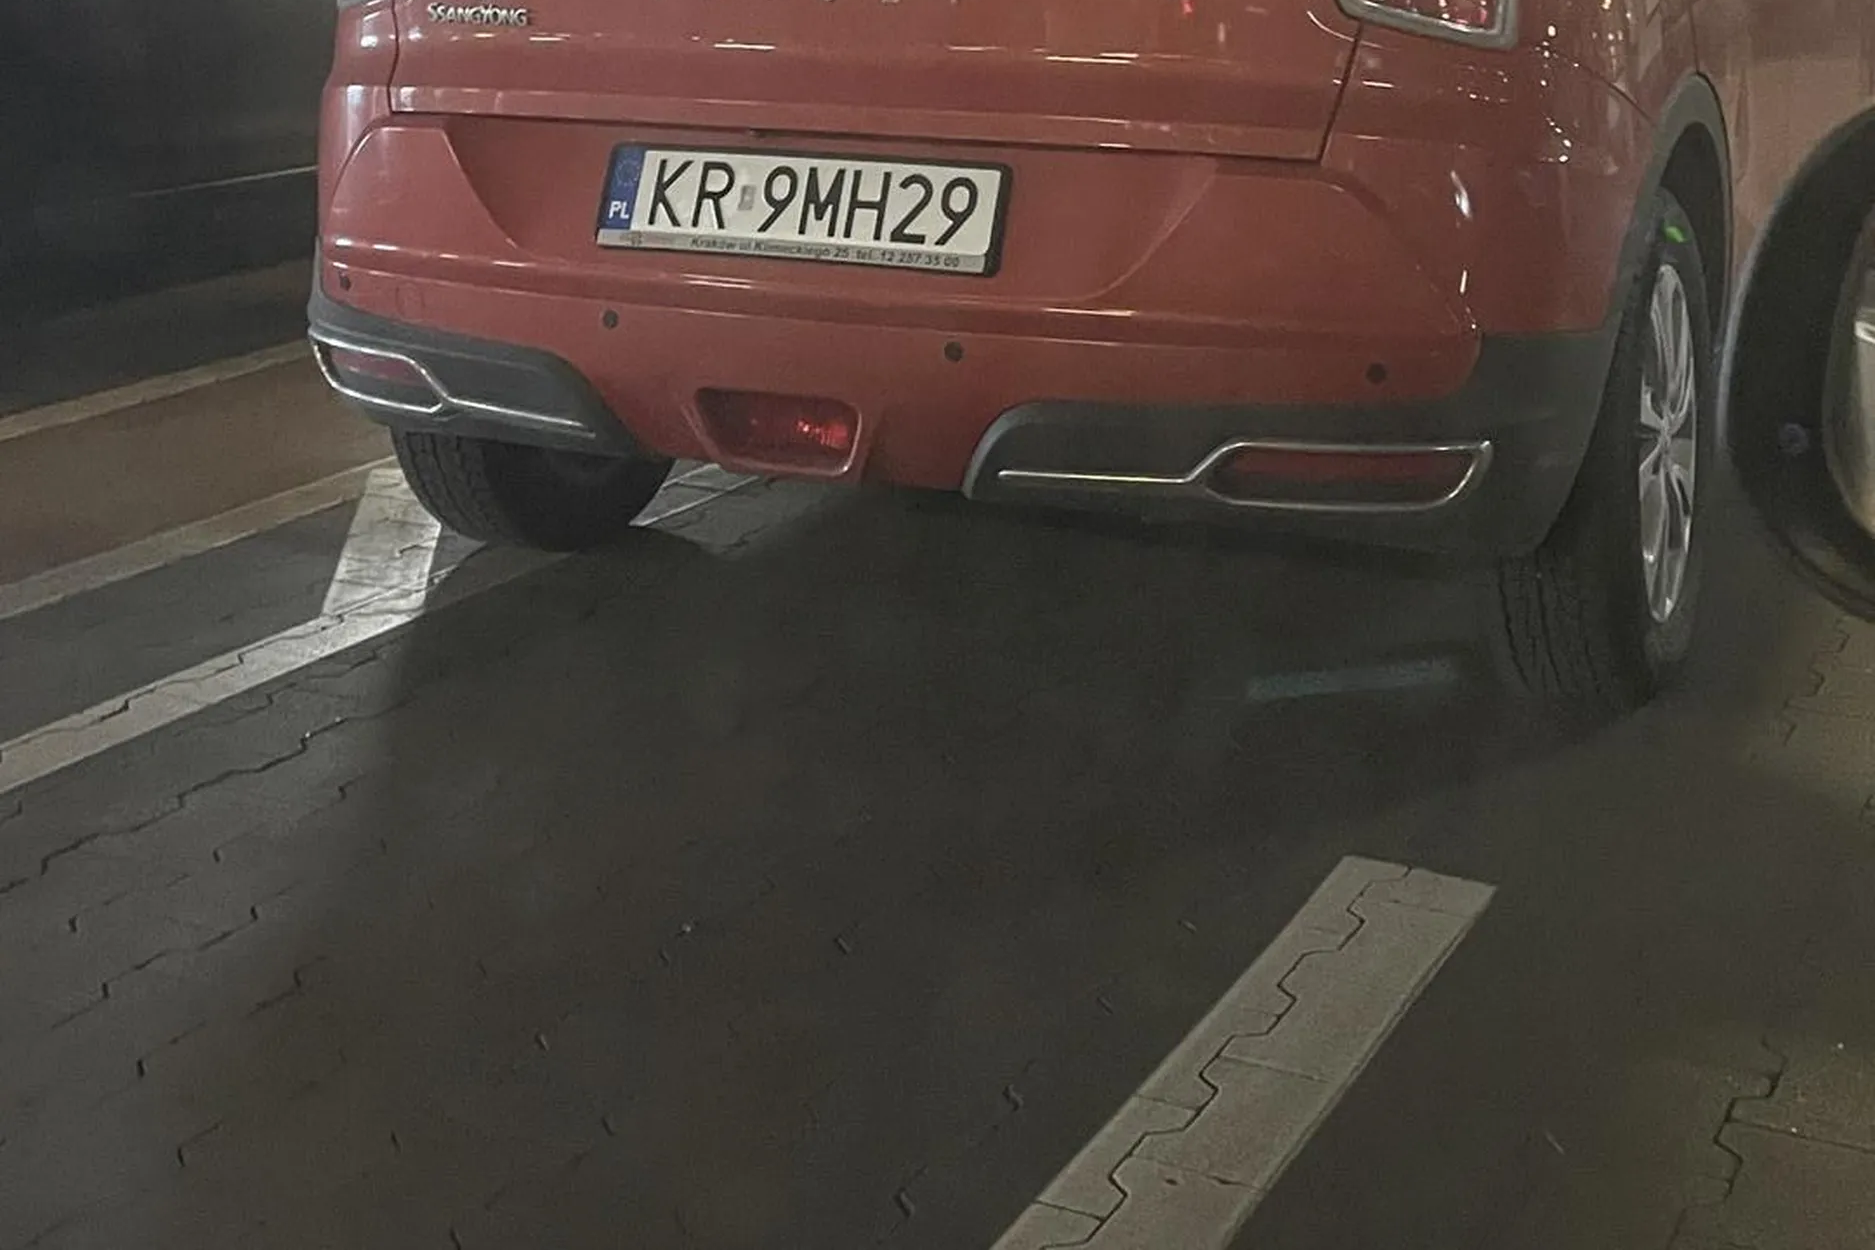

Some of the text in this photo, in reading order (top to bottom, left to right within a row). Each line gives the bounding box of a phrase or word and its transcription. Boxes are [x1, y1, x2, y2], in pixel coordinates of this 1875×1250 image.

[427, 2, 528, 26] SSANGYONG
[608, 200, 630, 219] PL
[648, 158, 979, 246] KR 9MH29
